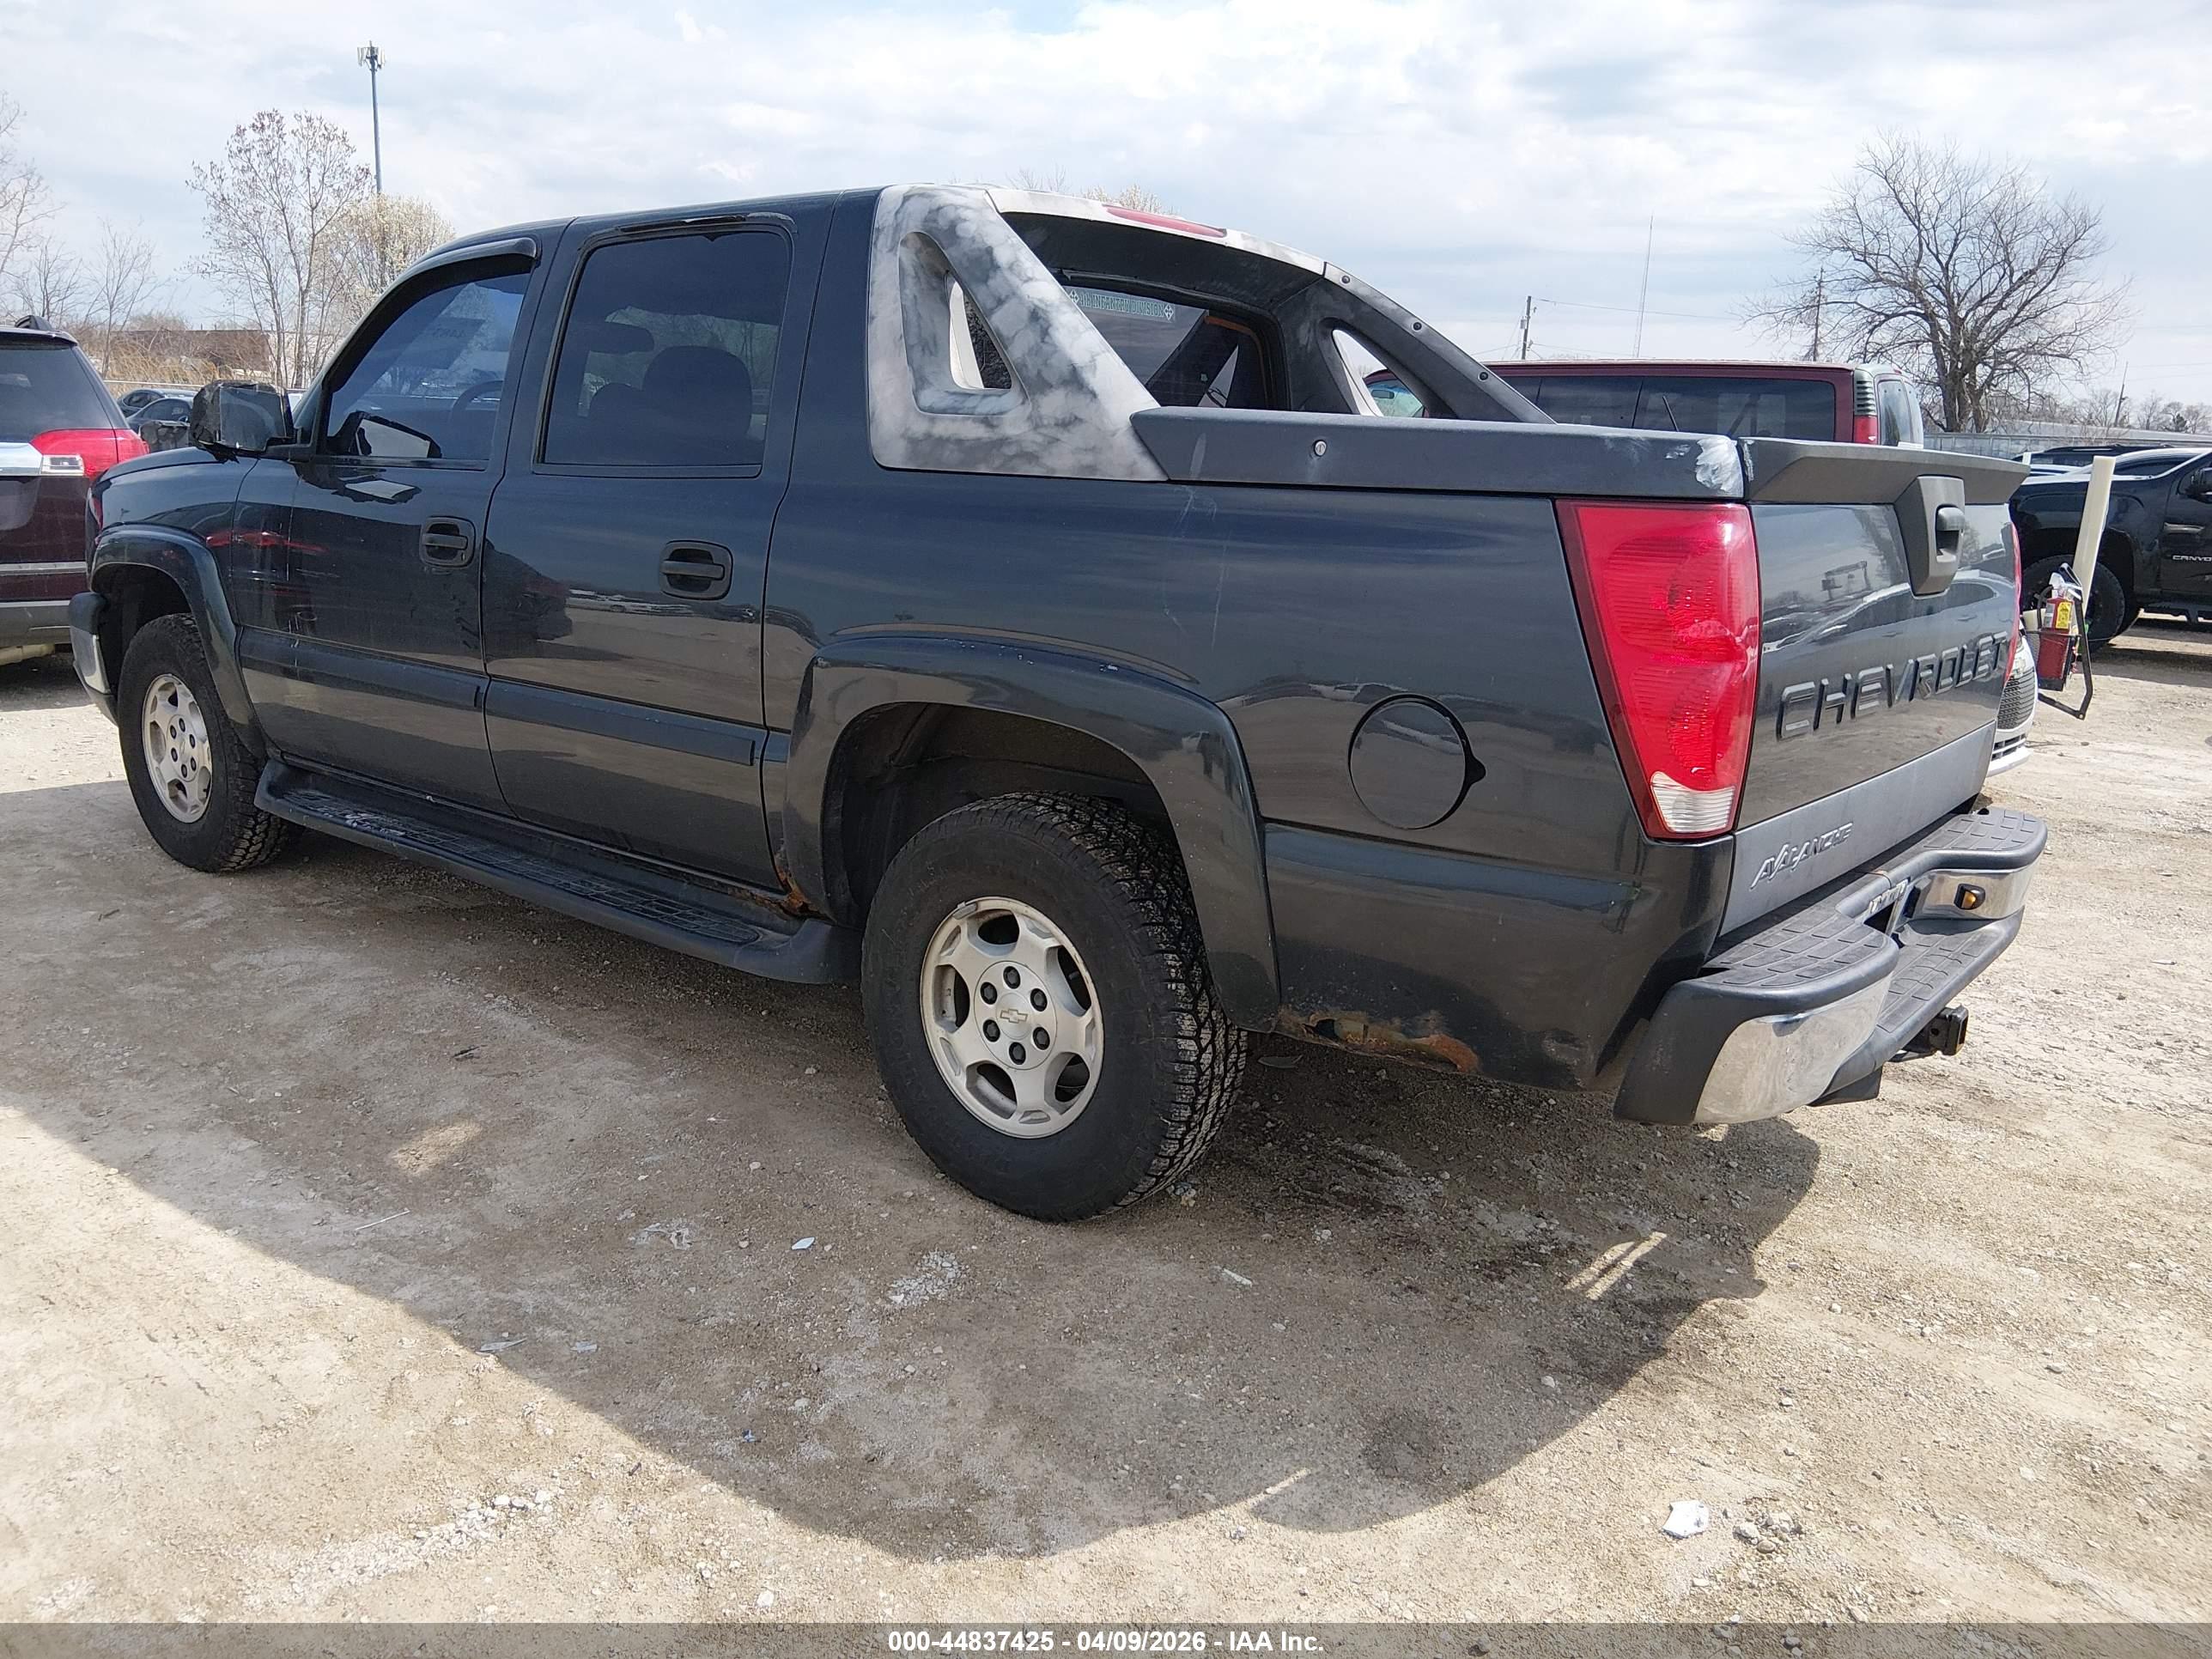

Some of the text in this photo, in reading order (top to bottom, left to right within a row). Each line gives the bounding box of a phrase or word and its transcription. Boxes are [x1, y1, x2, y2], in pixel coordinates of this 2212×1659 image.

[1092, 294, 1131, 313] INFANTRY
[1132, 300, 1164, 318] DIVISION
[1776, 631, 2008, 741] CHEVROLET
[1749, 822, 1853, 890] AVALANCHE
